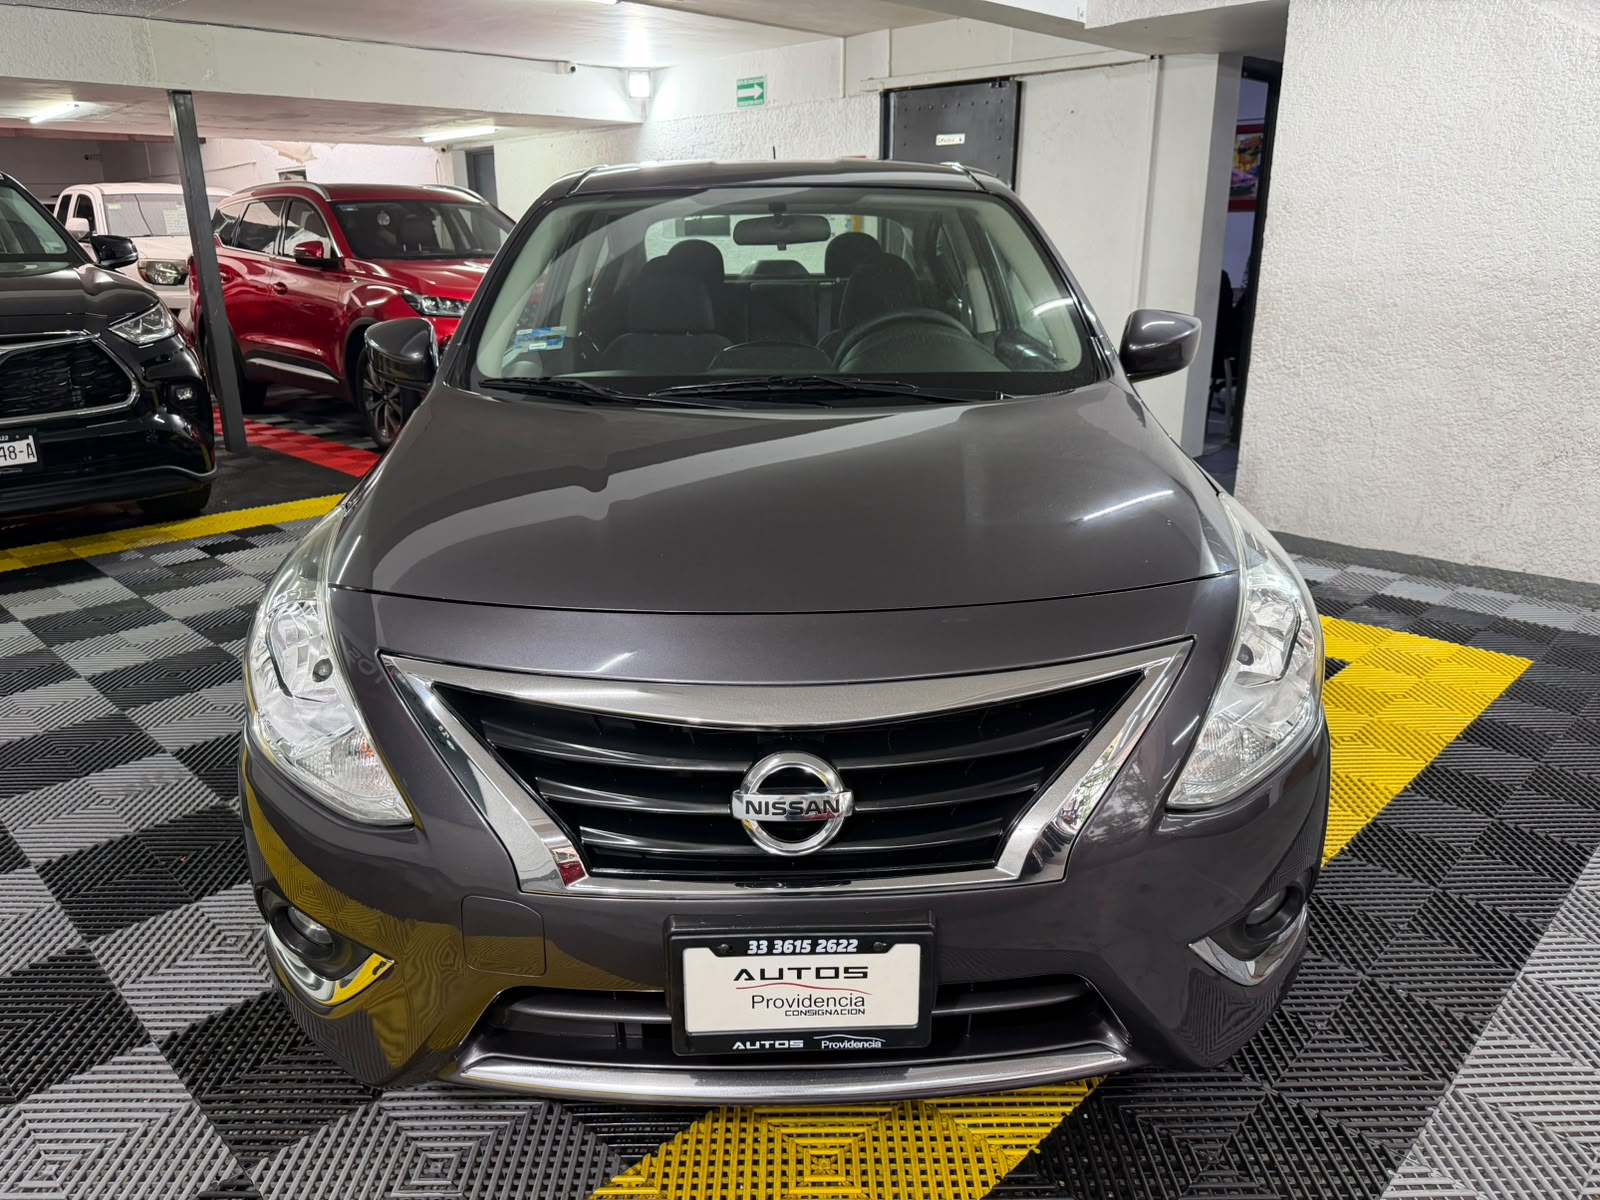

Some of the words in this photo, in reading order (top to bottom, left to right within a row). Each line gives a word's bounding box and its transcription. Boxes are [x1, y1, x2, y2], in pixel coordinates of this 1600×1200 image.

[745, 800, 840, 816] NISSAN
[747, 940, 768, 954] 33
[772, 939, 812, 953] 3615
[815, 939, 858, 952] 2622
[733, 966, 868, 980] AUTOS
[751, 993, 865, 1009] Providencia
[784, 1008, 865, 1016] CONSIGNACION
[732, 1040, 804, 1050] AUTOS
[821, 1039, 882, 1050] Providencia
